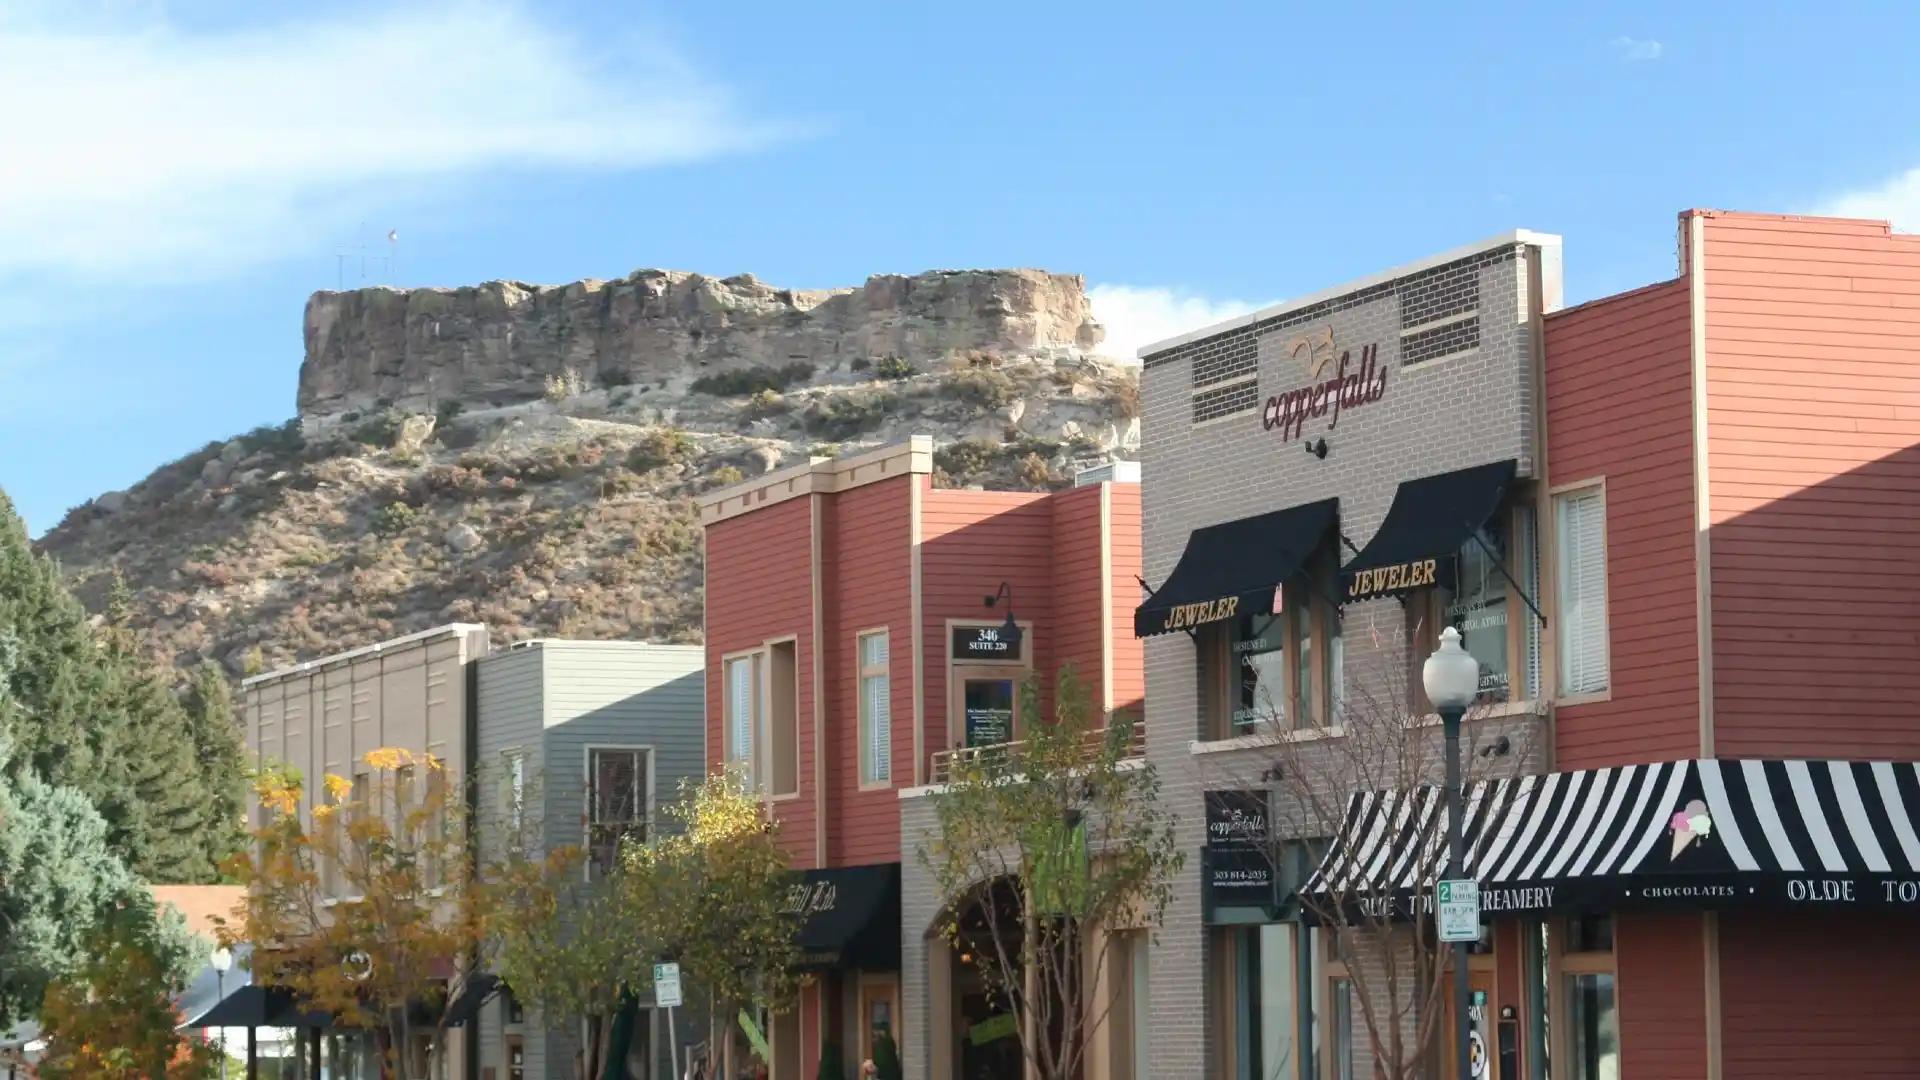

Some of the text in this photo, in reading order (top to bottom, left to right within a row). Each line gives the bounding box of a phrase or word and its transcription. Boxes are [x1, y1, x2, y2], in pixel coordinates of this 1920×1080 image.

[1263, 343, 1387, 442] copperfalls
[1348, 559, 1437, 597] JEWELER
[1164, 596, 1239, 630] JEWELER
[969, 642, 1007, 650] SUITE 220
[1214, 871, 1228, 880] 303
[1440, 885, 1449, 901] 2
[1476, 886, 1554, 911] CREAMERY
[1642, 886, 1735, 897] CHOCOLATES
[1787, 880, 1920, 902] OLDE TO
